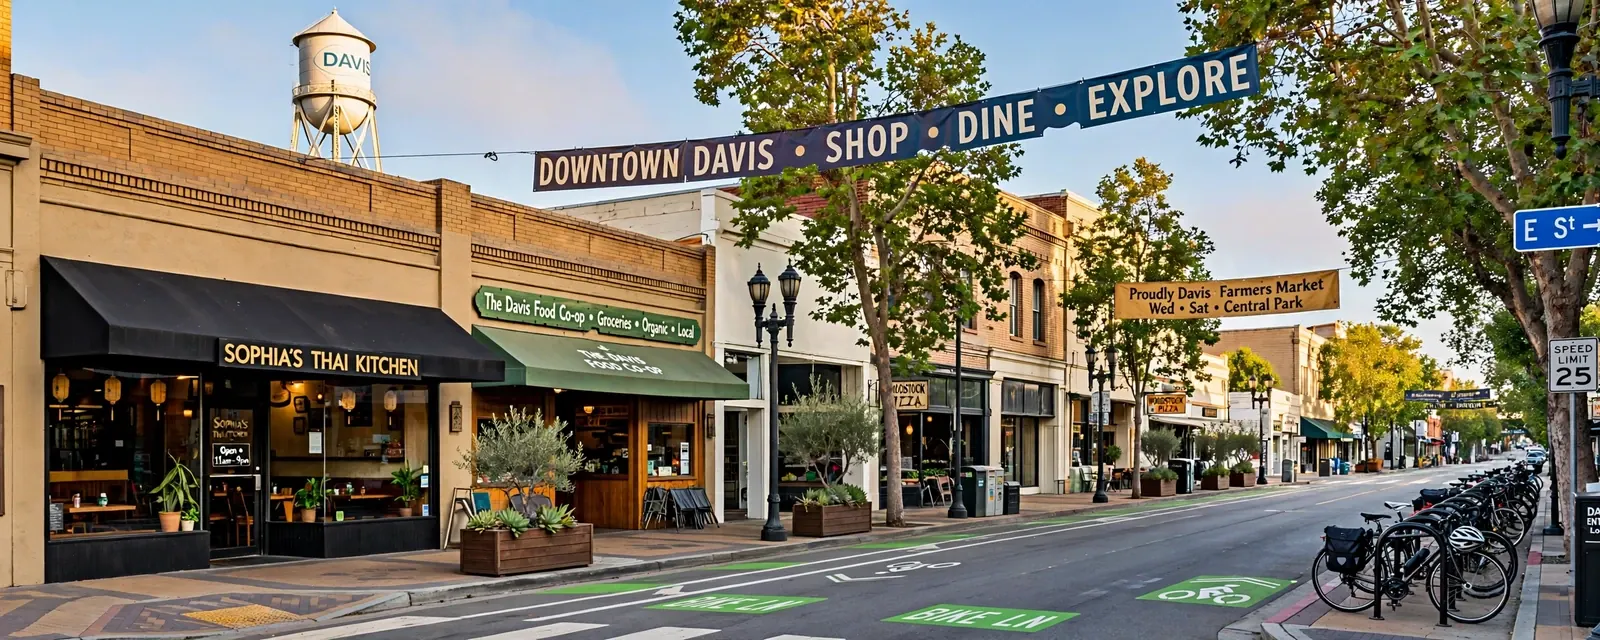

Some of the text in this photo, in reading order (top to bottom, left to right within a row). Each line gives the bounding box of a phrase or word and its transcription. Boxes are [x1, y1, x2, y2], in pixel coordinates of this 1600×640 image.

[539, 53, 1250, 187] DOWNTOWN DAVIS SHOP DINE EXPLORE
[1524, 215, 1576, 242] E St
[1129, 277, 1324, 302] Proudly Davis Farmers Market
[1149, 295, 1303, 315] Wed Sat Central Park
[484, 292, 695, 339] The Davis Food Co-op Groceries Organic Local
[1554, 344, 1593, 354] SPEED
[224, 343, 419, 377] SOPHIA'S THAI KITCHEN
[583, 359, 623, 371] FOOD
[1558, 355, 1589, 365] LIMIT
[1556, 367, 1592, 386] 25
[894, 396, 924, 408] IZZA
[901, 608, 1058, 629] BIKE LN
